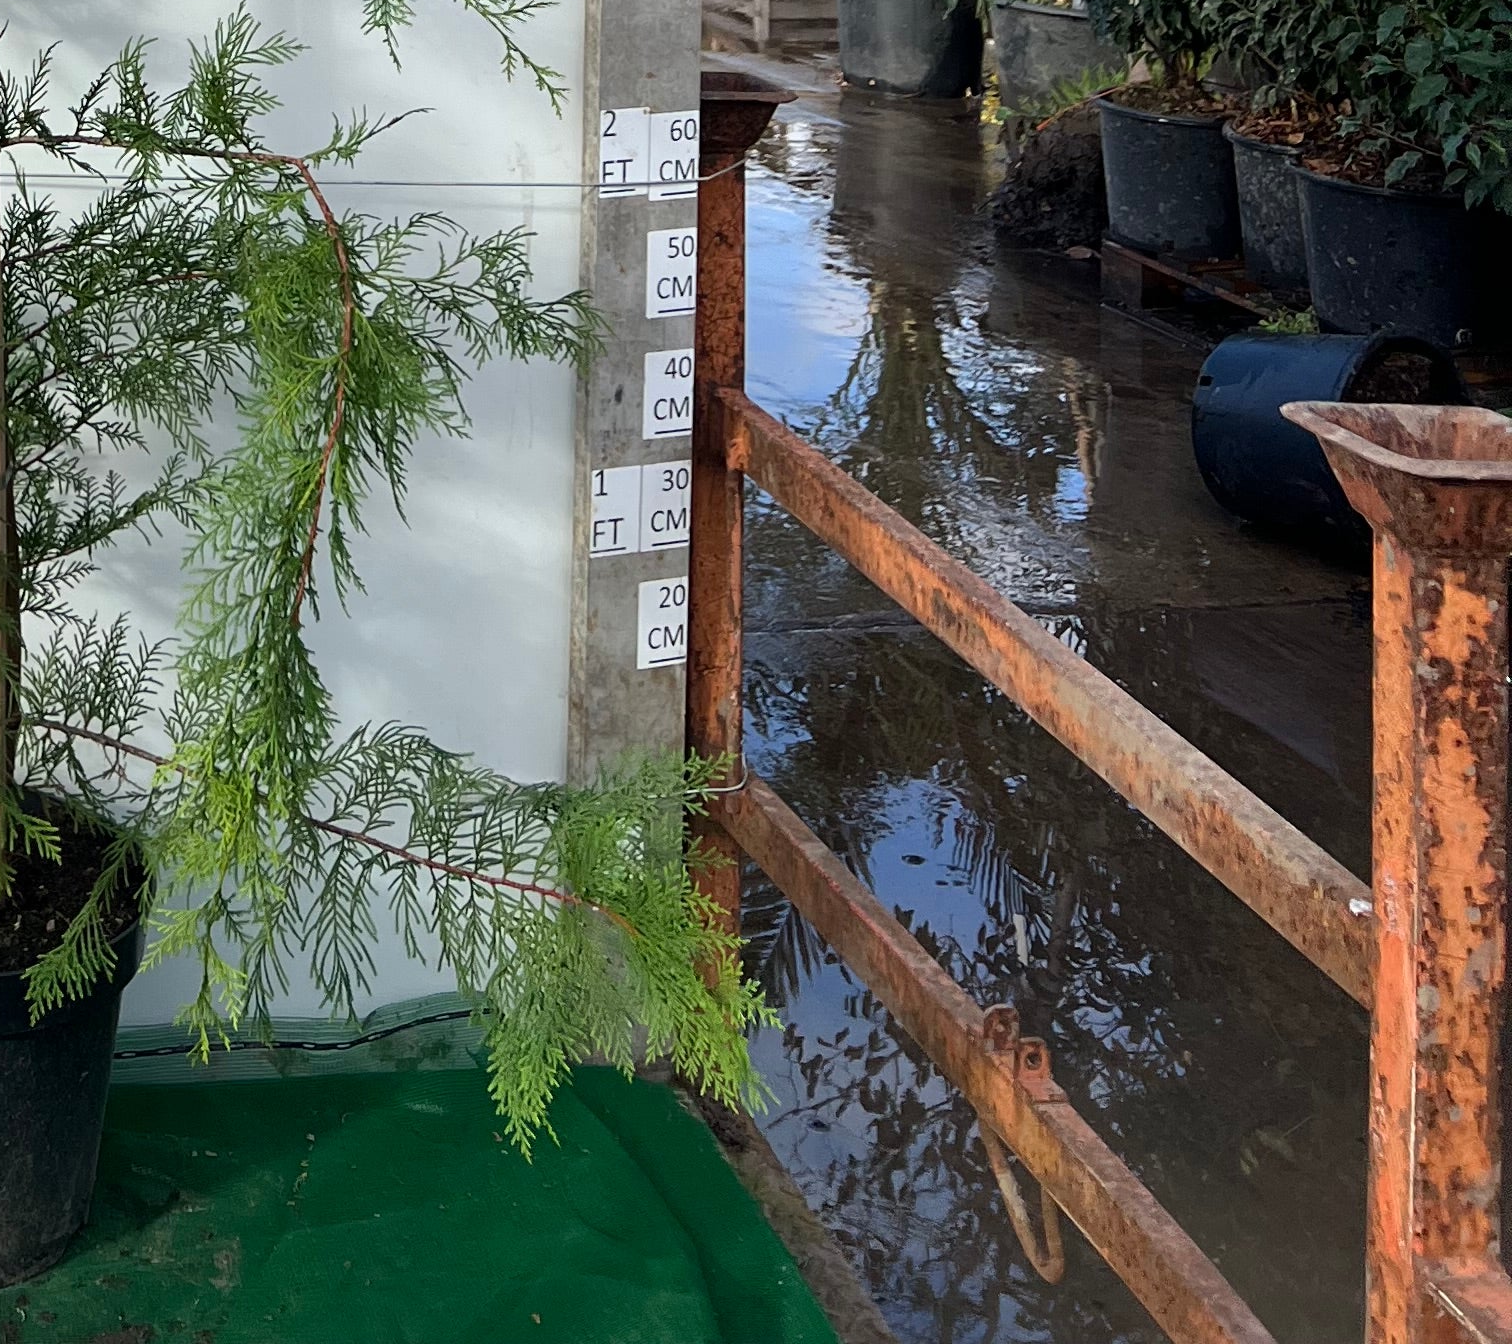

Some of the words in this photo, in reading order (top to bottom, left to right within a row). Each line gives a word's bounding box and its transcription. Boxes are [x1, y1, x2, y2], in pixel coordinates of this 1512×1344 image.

[602, 110, 617, 138] 2
[670, 118, 697, 142] 60
[602, 158, 634, 184] FT
[659, 157, 696, 182] CM
[667, 235, 694, 259] 50
[656, 275, 693, 300] CM
[664, 355, 692, 379] 40
[653, 395, 690, 421] CM
[593, 470, 608, 497] 1
[661, 467, 689, 492] 30
[592, 517, 625, 548] FT
[650, 507, 687, 533] CM
[658, 584, 686, 609] 20
[647, 623, 684, 650] CM
